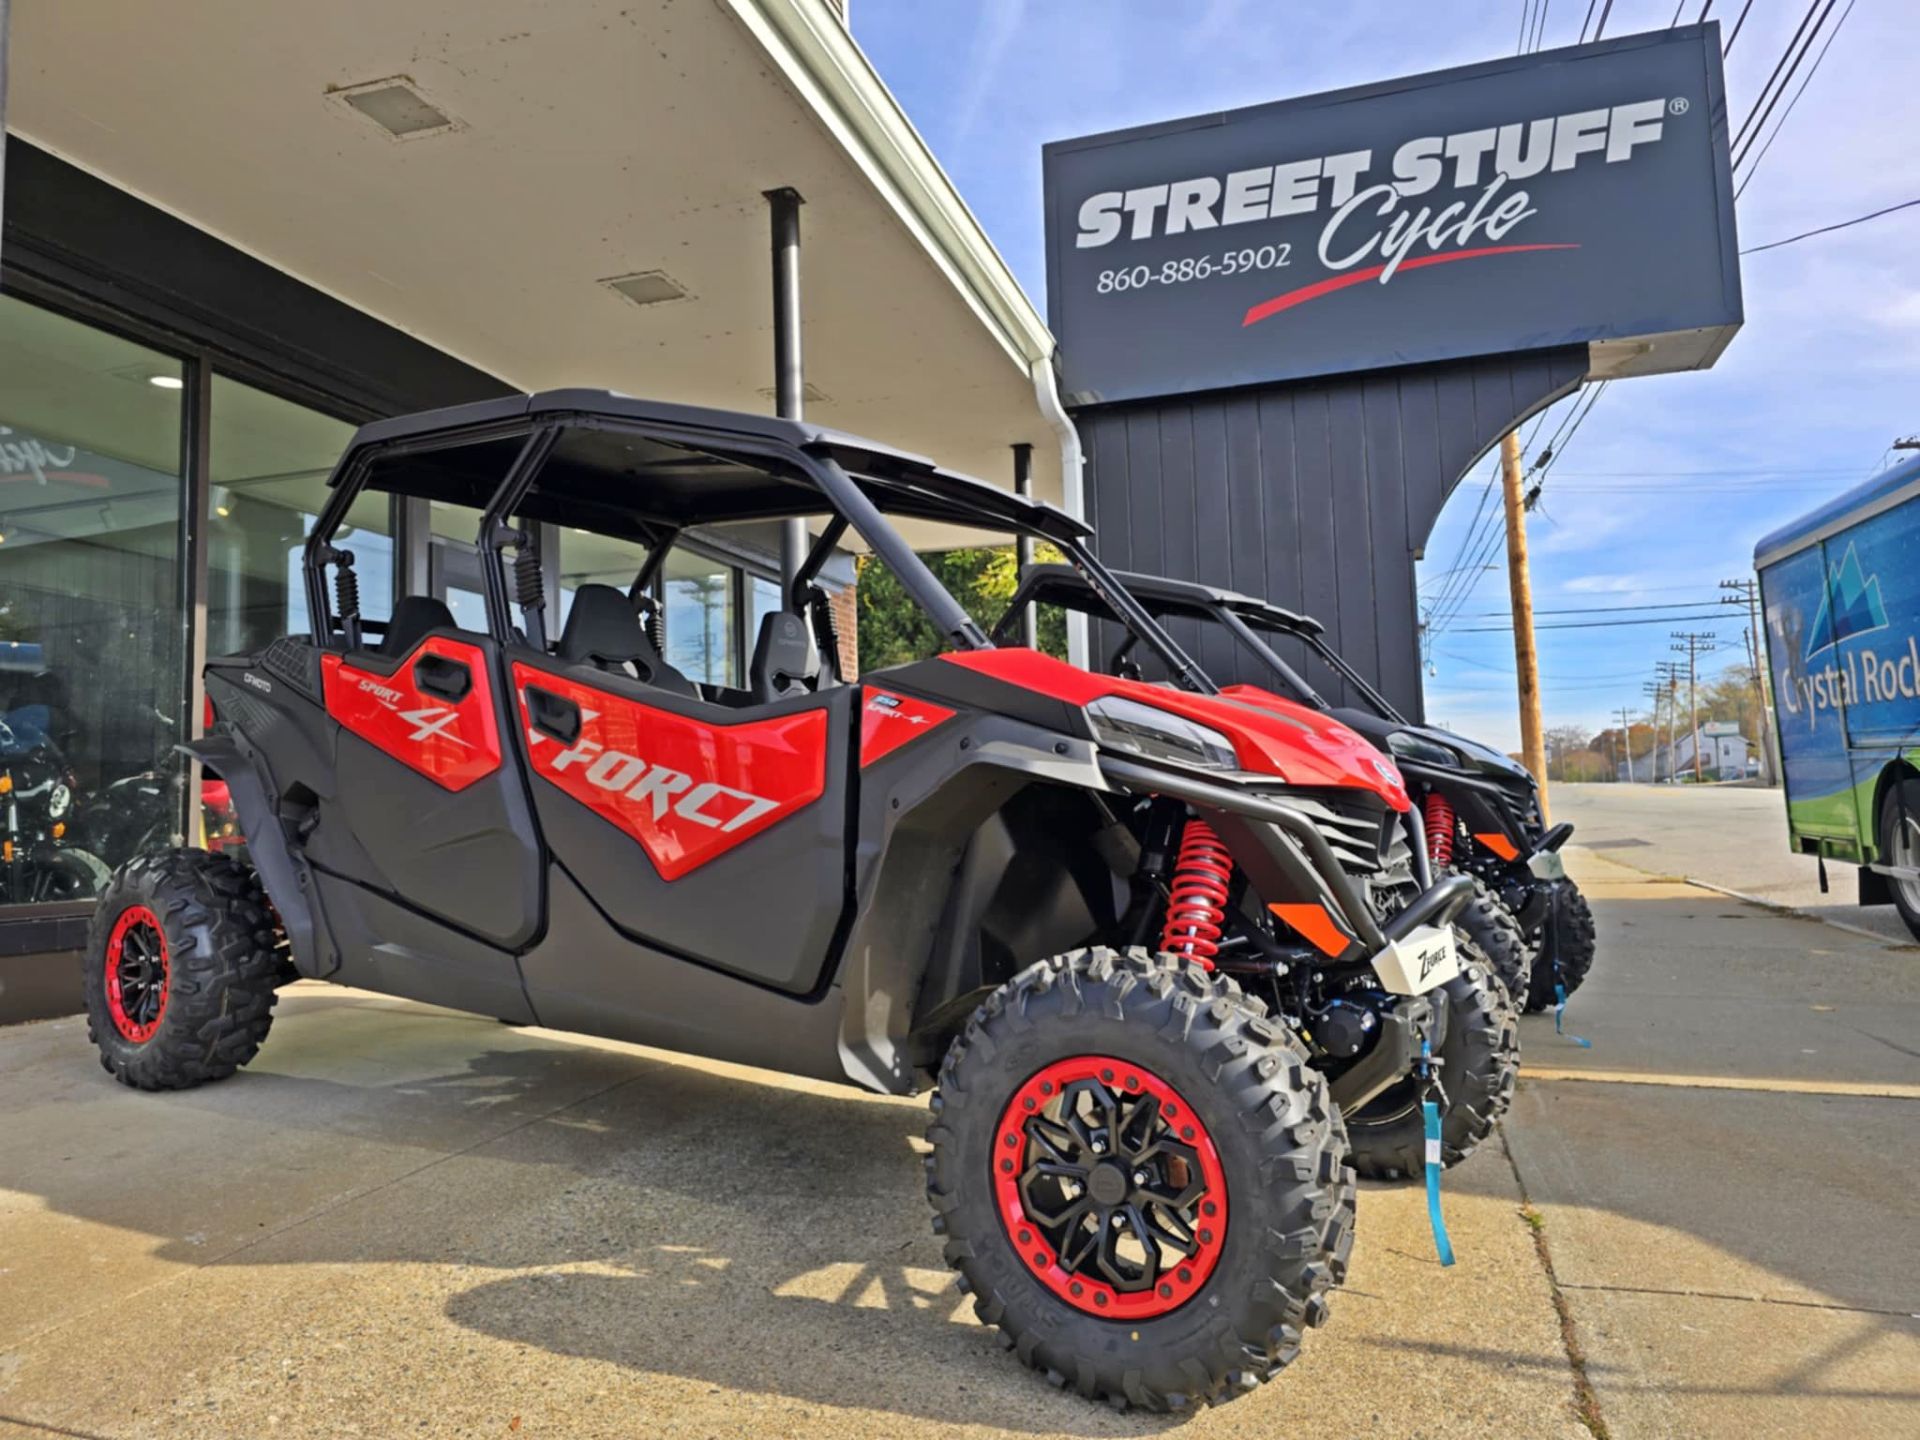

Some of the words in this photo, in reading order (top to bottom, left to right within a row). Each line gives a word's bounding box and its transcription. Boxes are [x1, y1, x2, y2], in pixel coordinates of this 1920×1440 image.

[1076, 149, 1372, 249] STREET
[1391, 98, 1666, 198] STUFF
[1097, 242, 1292, 294] 860-886-5902
[1318, 172, 1538, 284] Cycle
[358, 679, 404, 702] SPORT
[1782, 651, 1859, 735] Crystal
